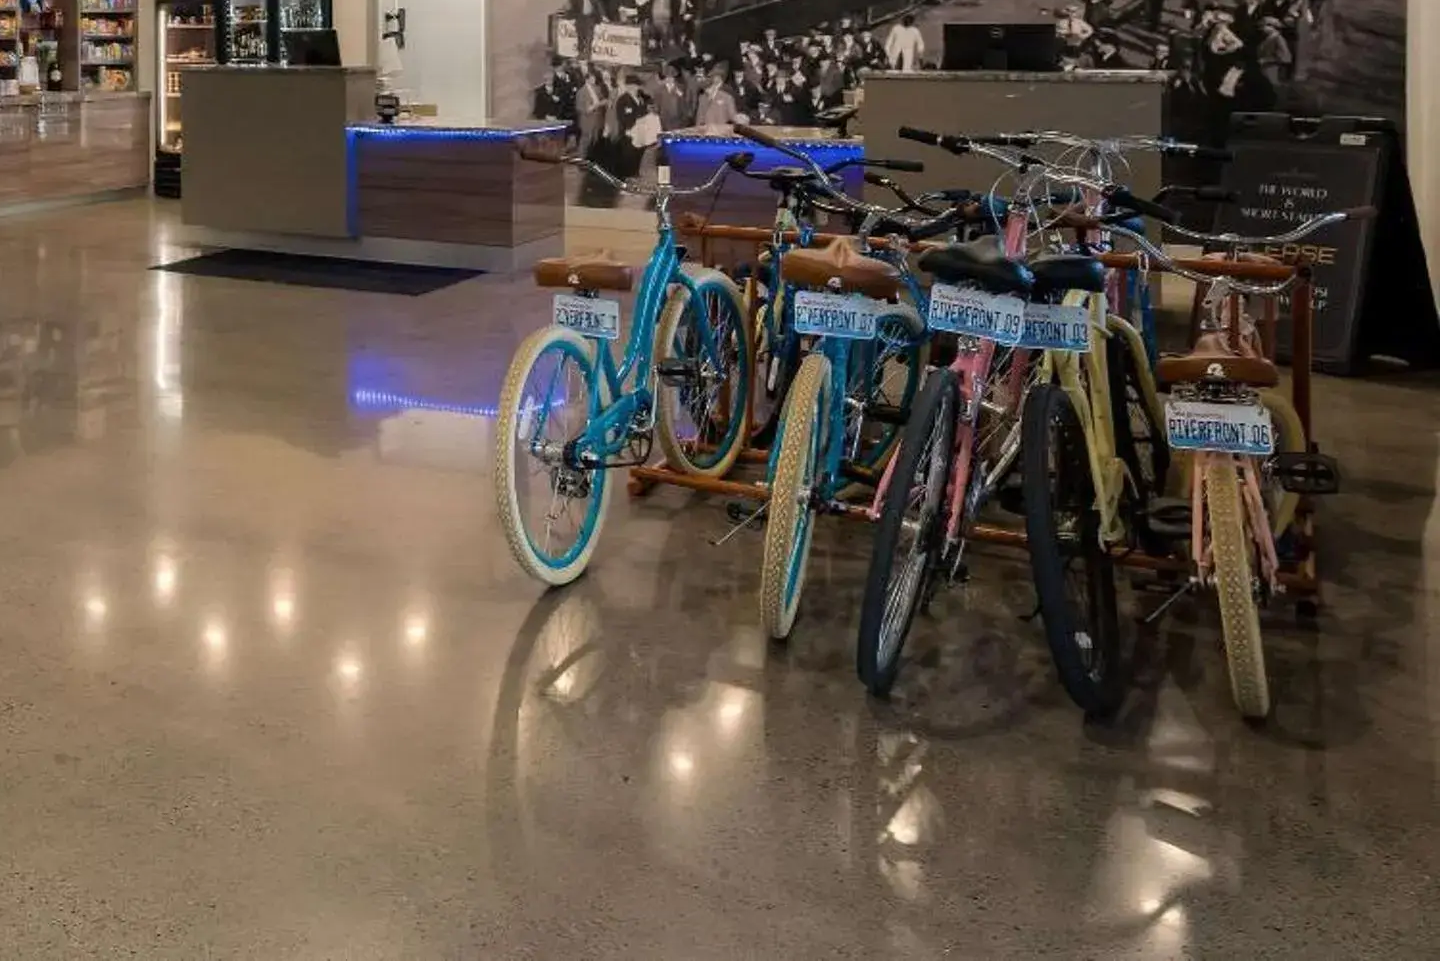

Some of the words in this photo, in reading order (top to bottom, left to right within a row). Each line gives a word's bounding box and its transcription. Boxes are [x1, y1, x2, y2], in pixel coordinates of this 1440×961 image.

[796, 305, 857, 331] RIVERFRONT
[931, 300, 1001, 329] RIVERFRONT
[1004, 313, 1021, 334] 09
[1025, 319, 1068, 341] RFRONT
[1071, 323, 1088, 343] 03
[1168, 419, 1247, 444] RIVERFRONT
[1251, 424, 1271, 445] 06
